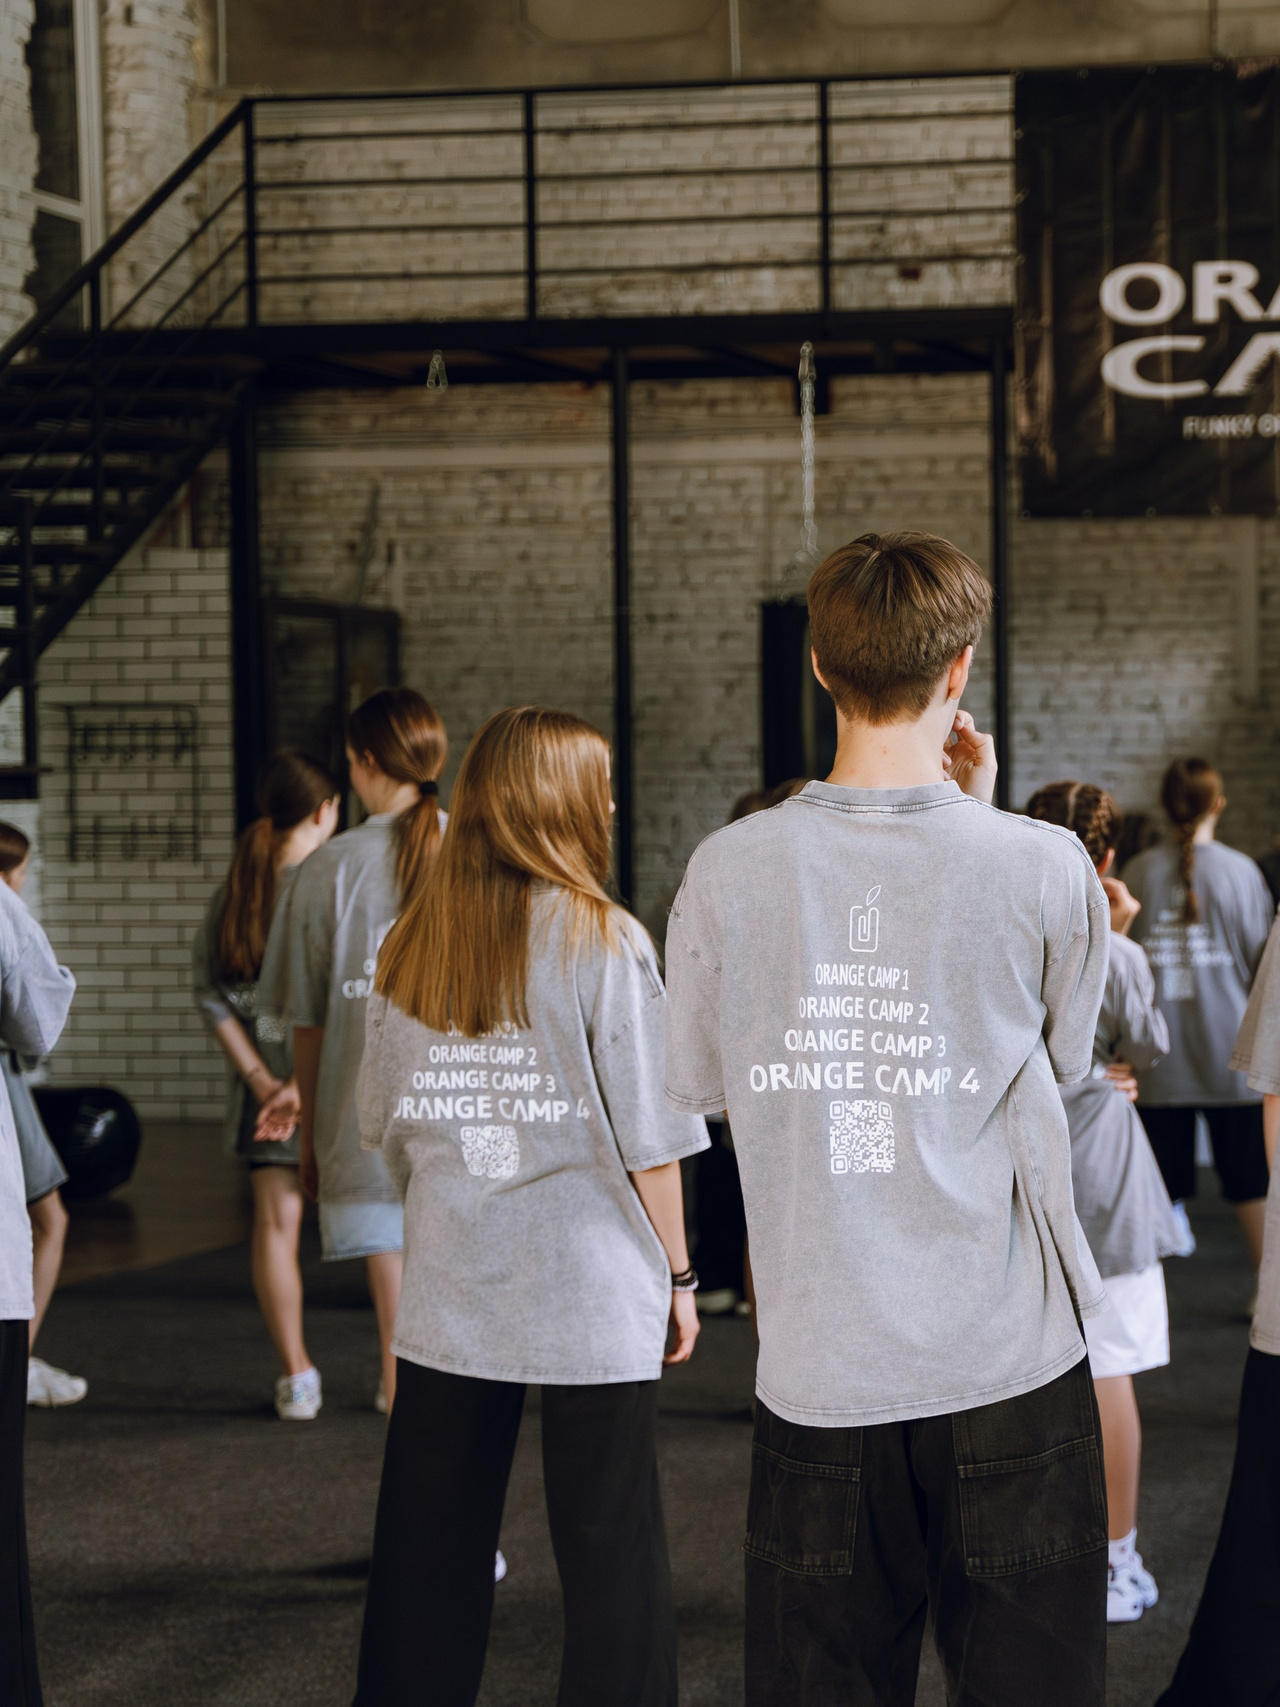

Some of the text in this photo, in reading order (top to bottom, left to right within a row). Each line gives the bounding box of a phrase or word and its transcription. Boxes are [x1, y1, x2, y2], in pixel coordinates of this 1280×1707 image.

[1182, 413, 1257, 440] FUNKY
[815, 963, 910, 990] ORANGE CAMP 1
[799, 996, 930, 1025] ORANGE CAMP 2
[428, 1044, 537, 1066] ORANGE CAMP 2
[784, 1029, 946, 1058] ORANGE CAMP 3
[412, 1069, 556, 1093] ORANGE CAMP 3
[749, 1061, 981, 1096] ORANGE CAMP 4
[499, 1097, 569, 1123] CAMP
[576, 1097, 590, 1121] 4
